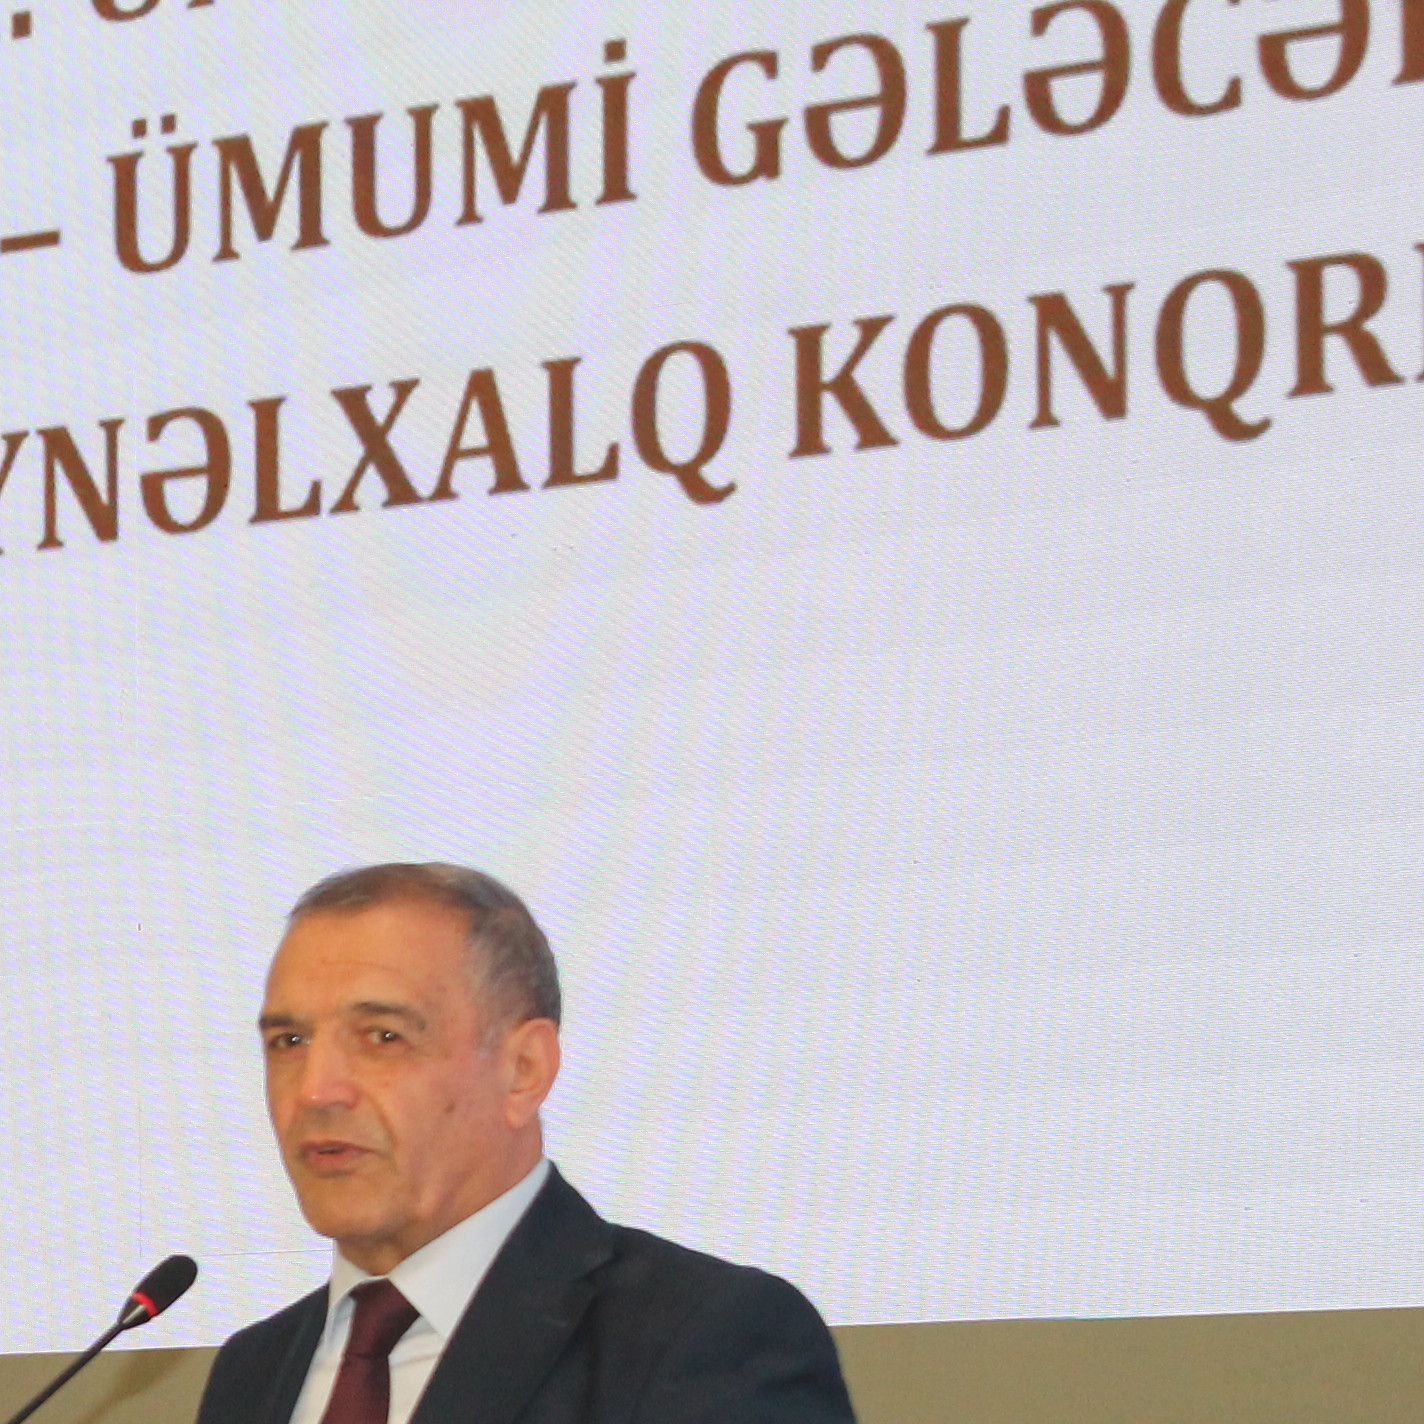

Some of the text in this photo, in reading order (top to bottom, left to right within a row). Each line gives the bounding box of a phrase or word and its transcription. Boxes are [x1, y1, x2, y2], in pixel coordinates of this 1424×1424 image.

[107, 39, 637, 274] ÜMUMİ
[691, 0, 1424, 187] GƏLƏCƏ
[788, 242, 1424, 459] KONQR
